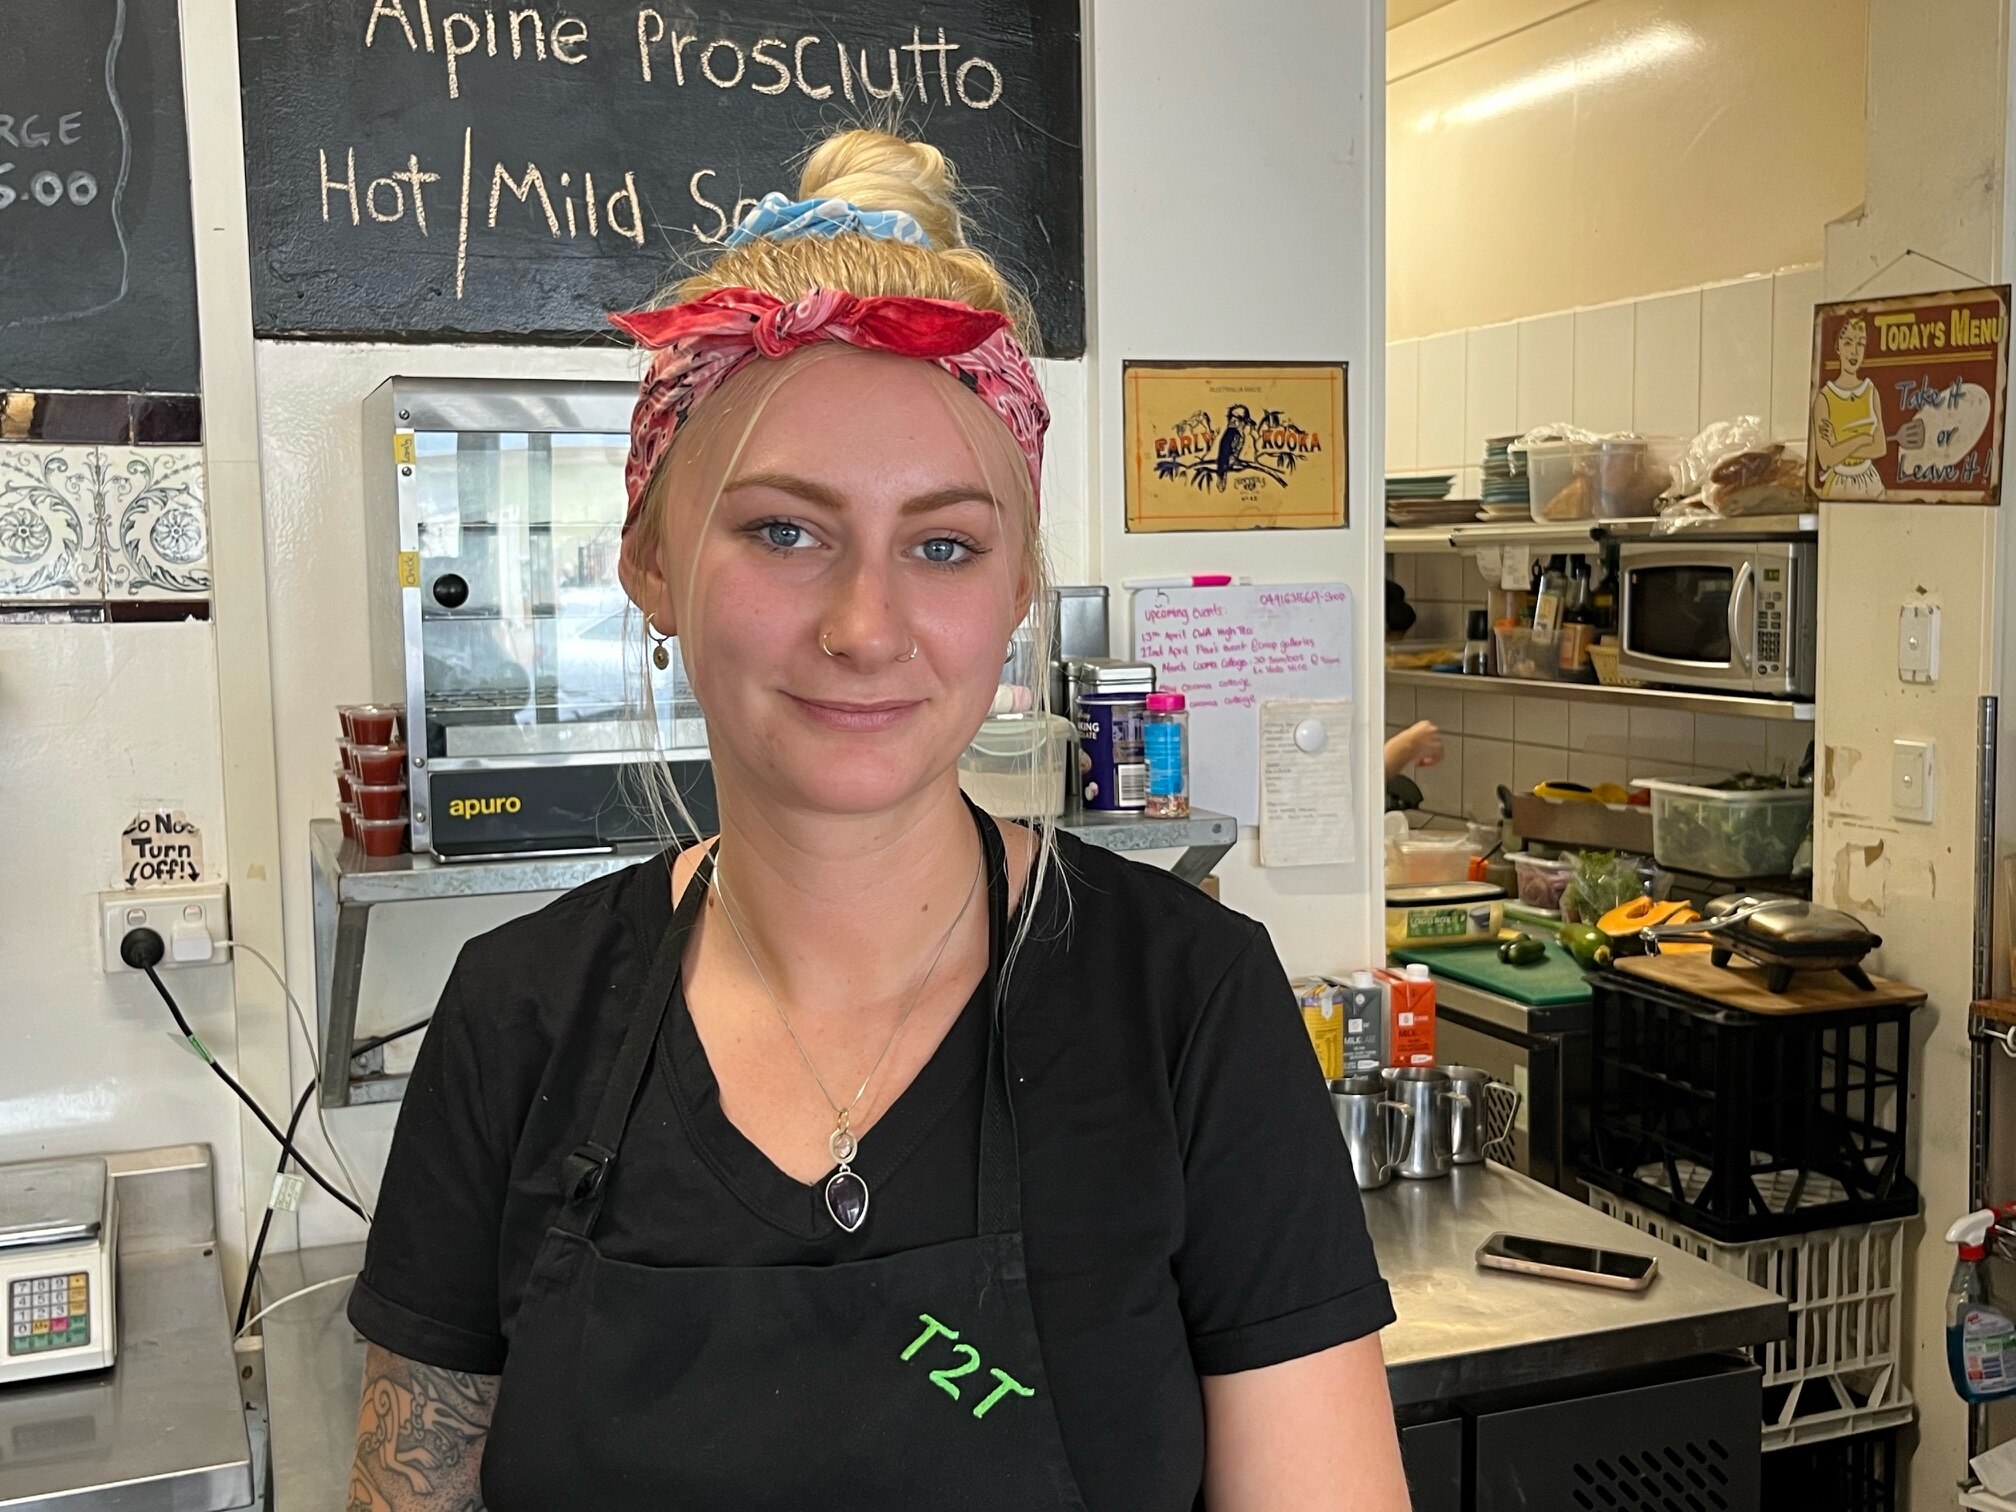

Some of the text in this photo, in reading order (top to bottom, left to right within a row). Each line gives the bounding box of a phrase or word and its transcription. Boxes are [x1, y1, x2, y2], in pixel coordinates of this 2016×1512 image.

[365, 0, 1003, 109] Alpine Prosciutto
[1895, 375, 1966, 411] Take it
[1154, 429, 1322, 459] EARLY KOOKA
[1937, 426, 1959, 447] or
[1897, 452, 1959, 484] Leave
[1165, 629, 1186, 642] April
[1168, 644, 1188, 659] April
[449, 796, 522, 820] apuro
[131, 837, 191, 859] Turn
[140, 858, 185, 880] Off!
[900, 1313, 1035, 1419] T2T
